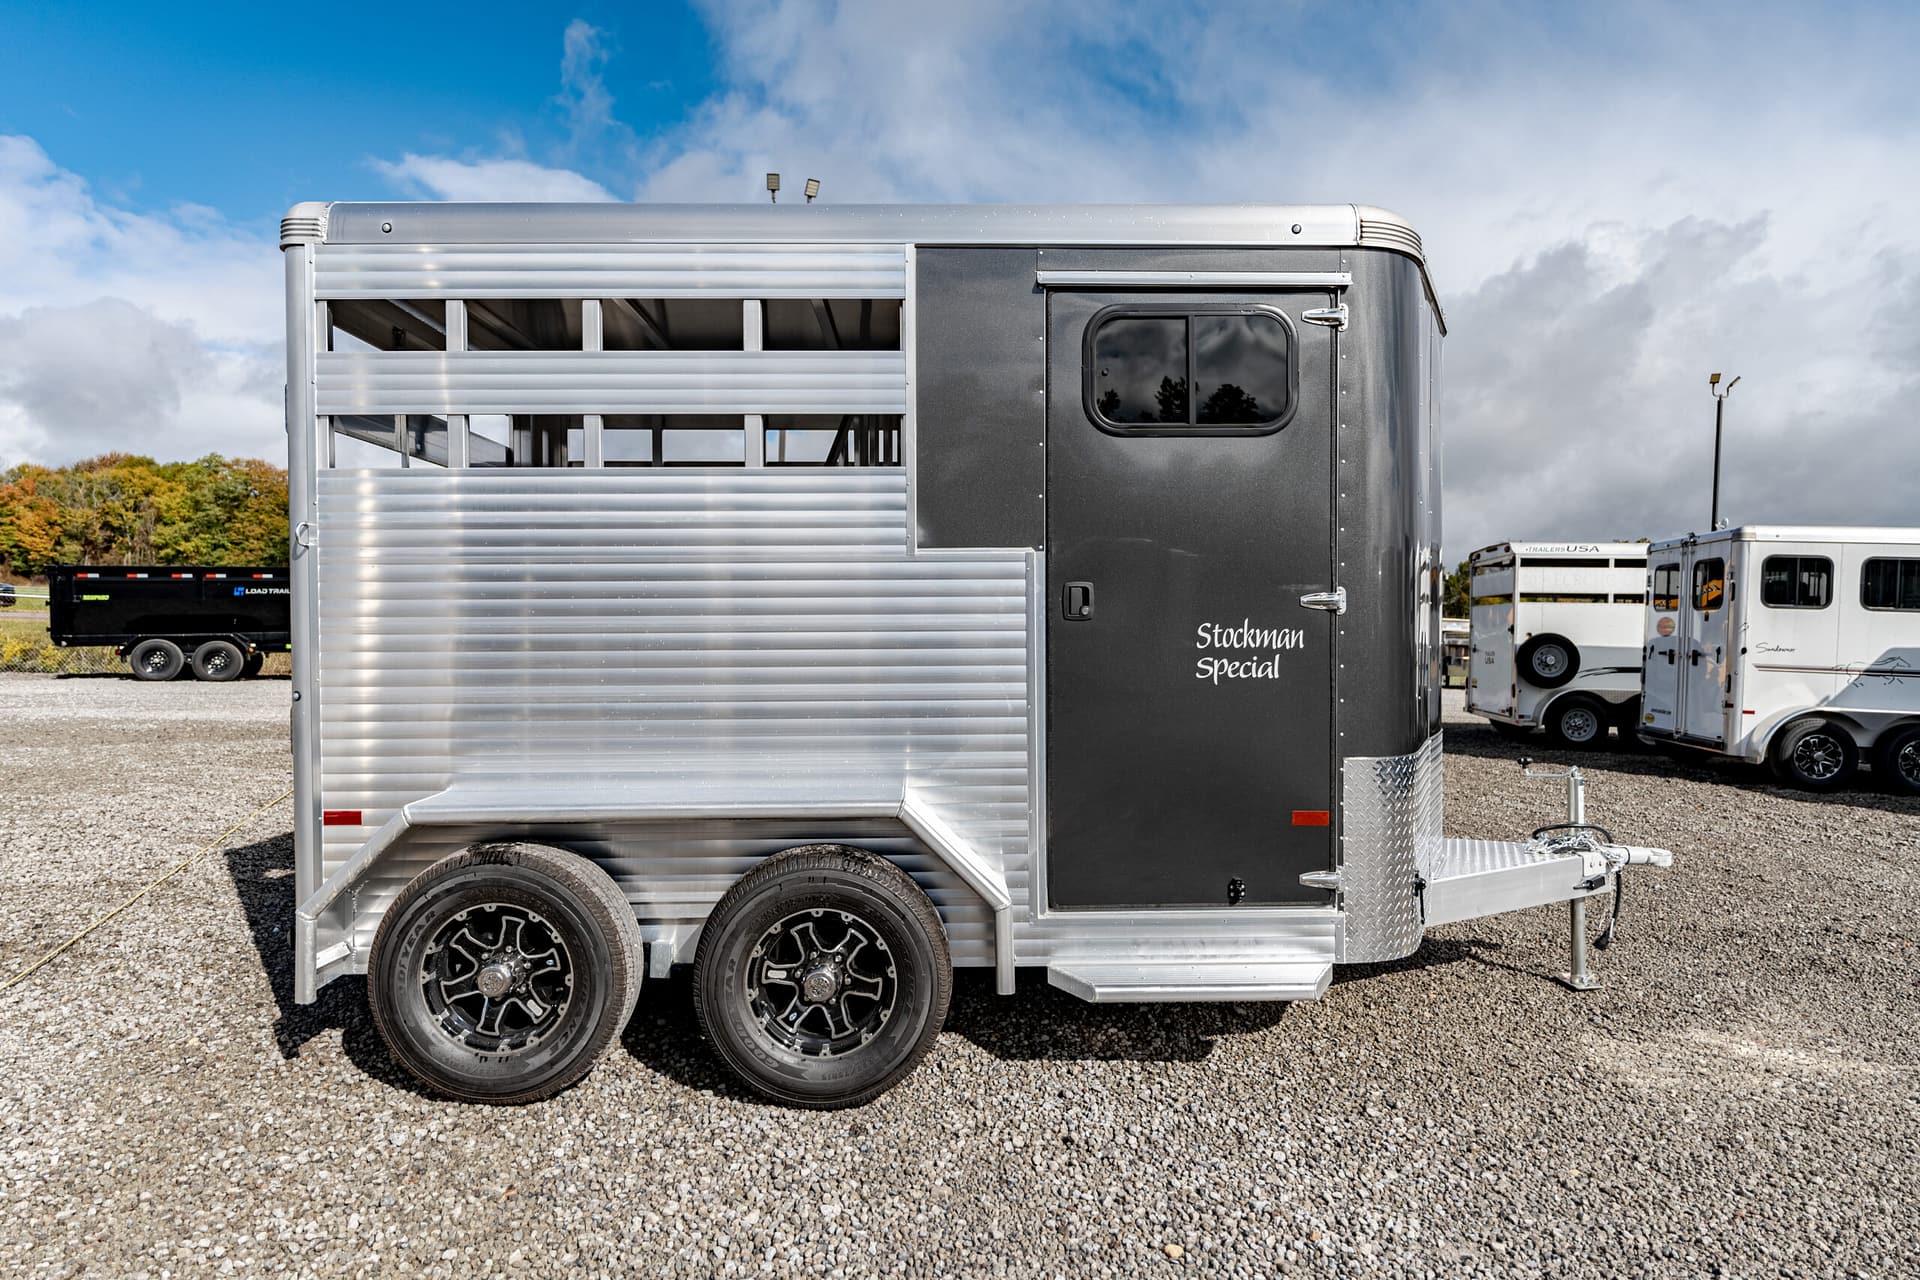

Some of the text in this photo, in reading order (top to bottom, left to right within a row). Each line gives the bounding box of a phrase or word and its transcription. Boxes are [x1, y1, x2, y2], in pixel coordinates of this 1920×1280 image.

[1566, 545, 1600, 553] USA
[1196, 617, 1304, 649] Stockman
[1196, 653, 1280, 685] Special
[725, 957, 779, 1068] GOODEAR
